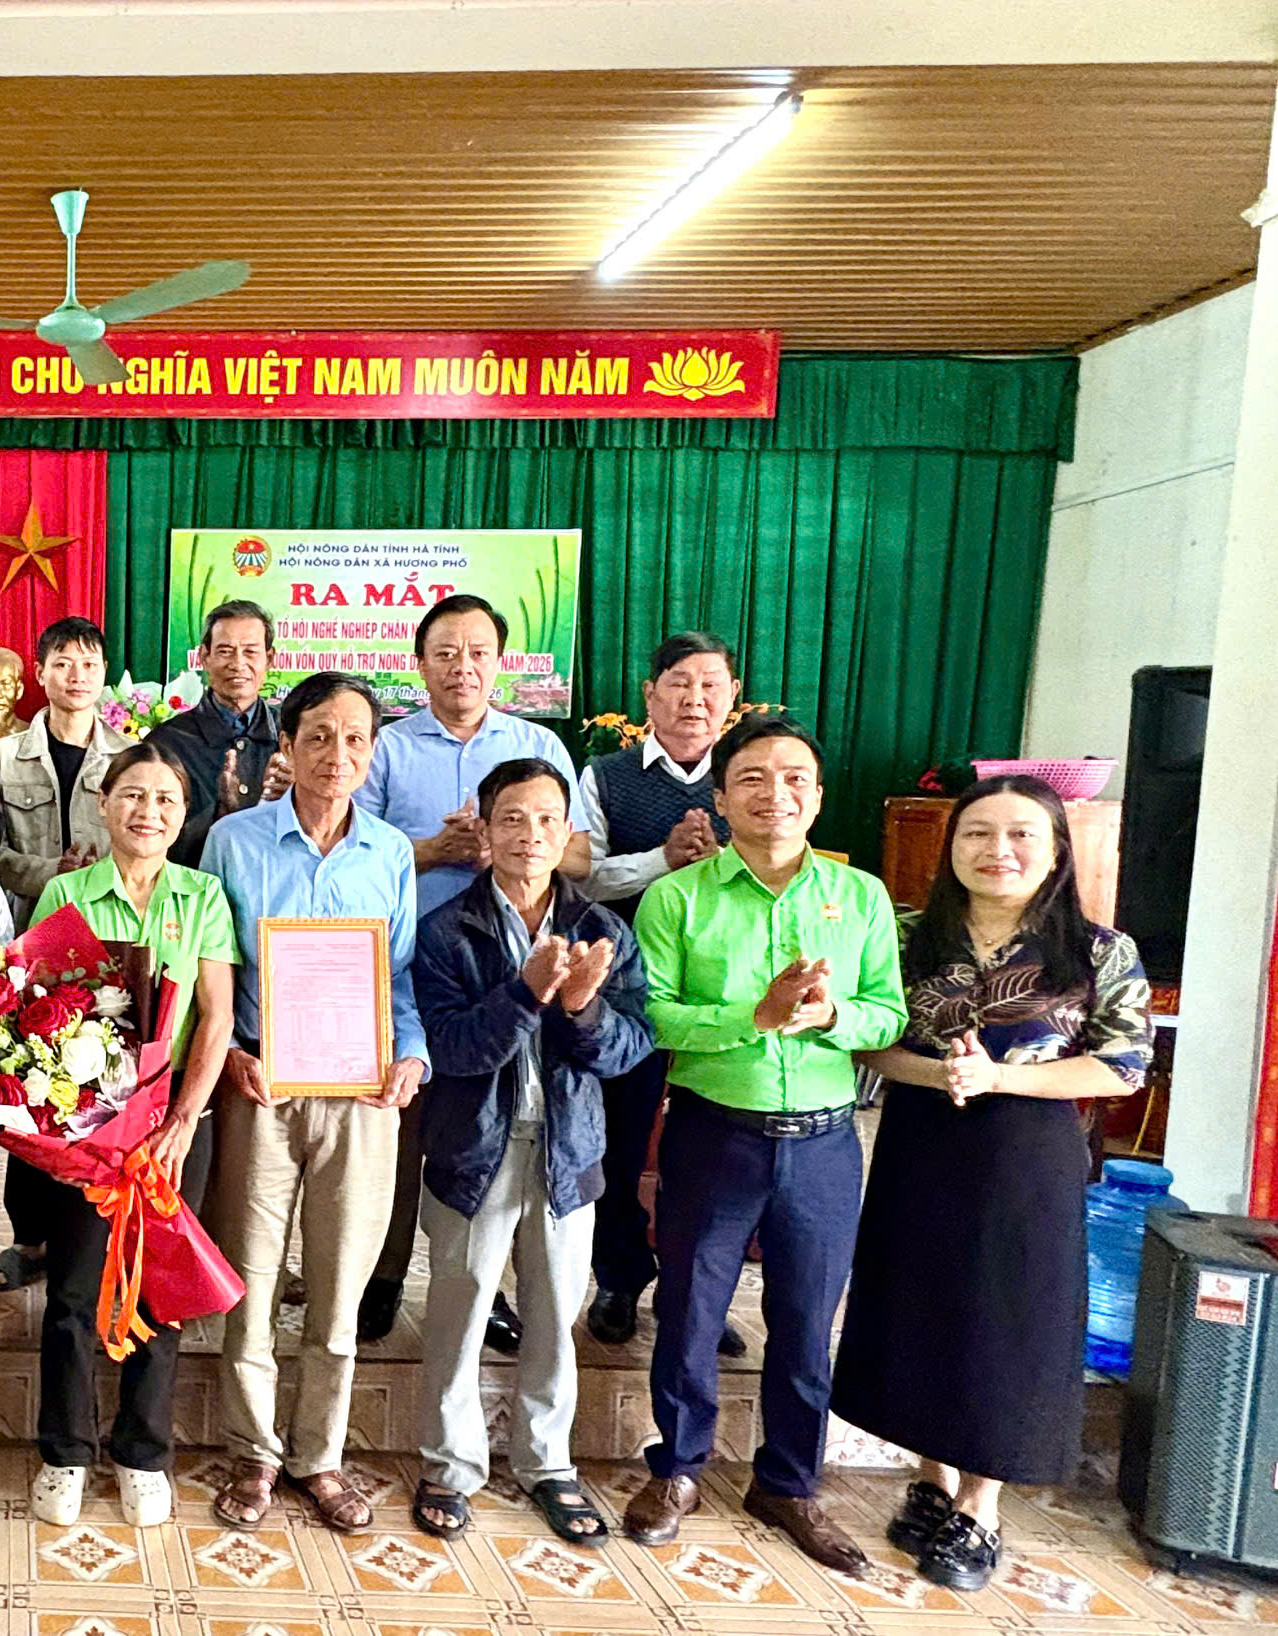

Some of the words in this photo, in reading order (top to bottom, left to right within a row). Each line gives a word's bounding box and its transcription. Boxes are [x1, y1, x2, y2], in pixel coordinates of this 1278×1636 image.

[223, 349, 303, 403] VIỆT
[313, 357, 402, 395] NAM
[414, 350, 528, 396] MUÔN
[539, 350, 630, 396] NĂM
[288, 543, 310, 555] HỘI
[313, 543, 350, 554] NÔNG
[353, 543, 379, 554] DÂN
[412, 543, 429, 554] HÀ
[279, 557, 301, 568] HỘI
[304, 557, 341, 568] NÔNG
[344, 557, 370, 567] DÂN
[374, 557, 390, 567] XÃ
[394, 558, 438, 568] HƯƠNG
[442, 556, 468, 568] PHỐ
[290, 583, 350, 607] RA
[363, 571, 455, 607] MẮT
[378, 650, 407, 671] NÔNG
[501, 650, 525, 673] NĂM
[527, 655, 552, 673] 2026
